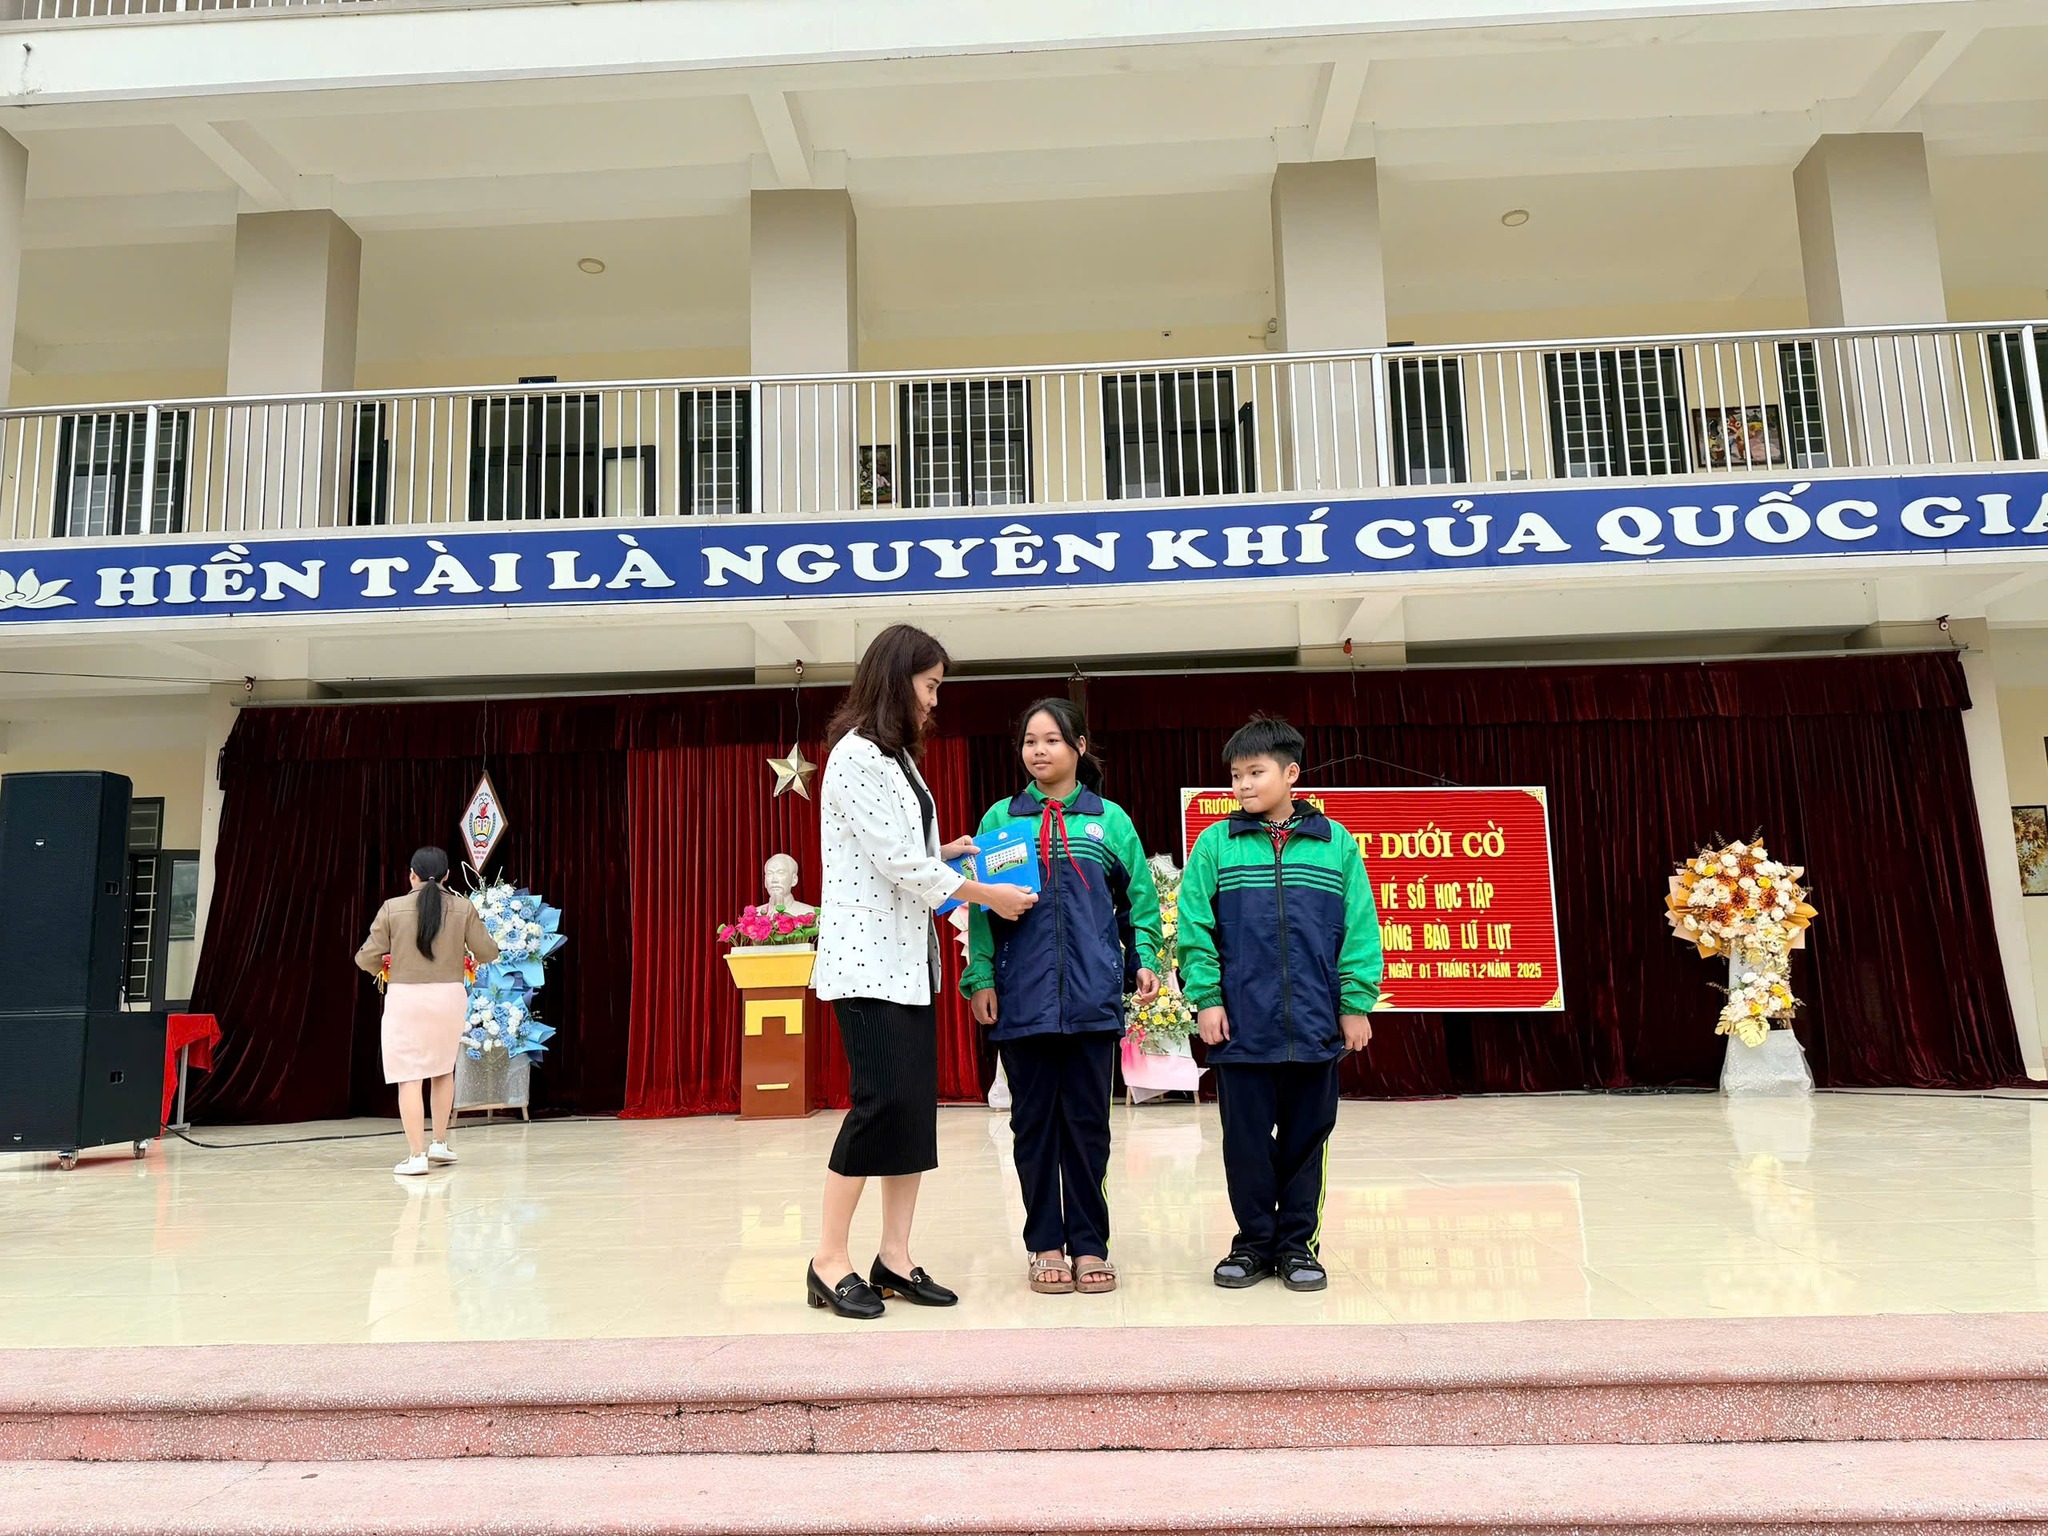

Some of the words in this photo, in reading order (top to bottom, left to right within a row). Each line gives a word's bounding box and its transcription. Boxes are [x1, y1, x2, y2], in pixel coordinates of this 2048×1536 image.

[95, 543, 326, 607] HIỀN
[349, 539, 523, 597] TÀI
[545, 533, 676, 590] LÀ
[702, 523, 1120, 586] NGUYÊN
[1146, 506, 1330, 570] KHÍ
[1354, 499, 1572, 560] CỦA
[1597, 481, 1879, 556] QUỐC
[1379, 821, 1453, 858] DƯỚI
[1461, 820, 1505, 858] CỜ
[1380, 875, 1399, 910] VÉ
[1406, 874, 1429, 910] SỐ
[1434, 881, 1463, 913] HỌC
[1466, 876, 1495, 914] TẬP
[1423, 918, 1451, 951] BÀO
[1460, 919, 1479, 950] LŨ
[1486, 923, 1512, 955] LỤT
[1419, 963, 1431, 979] 01
[1436, 957, 1470, 978] THÁNG
[1487, 958, 1512, 978] NĂM
[1517, 962, 1542, 978] 2025
